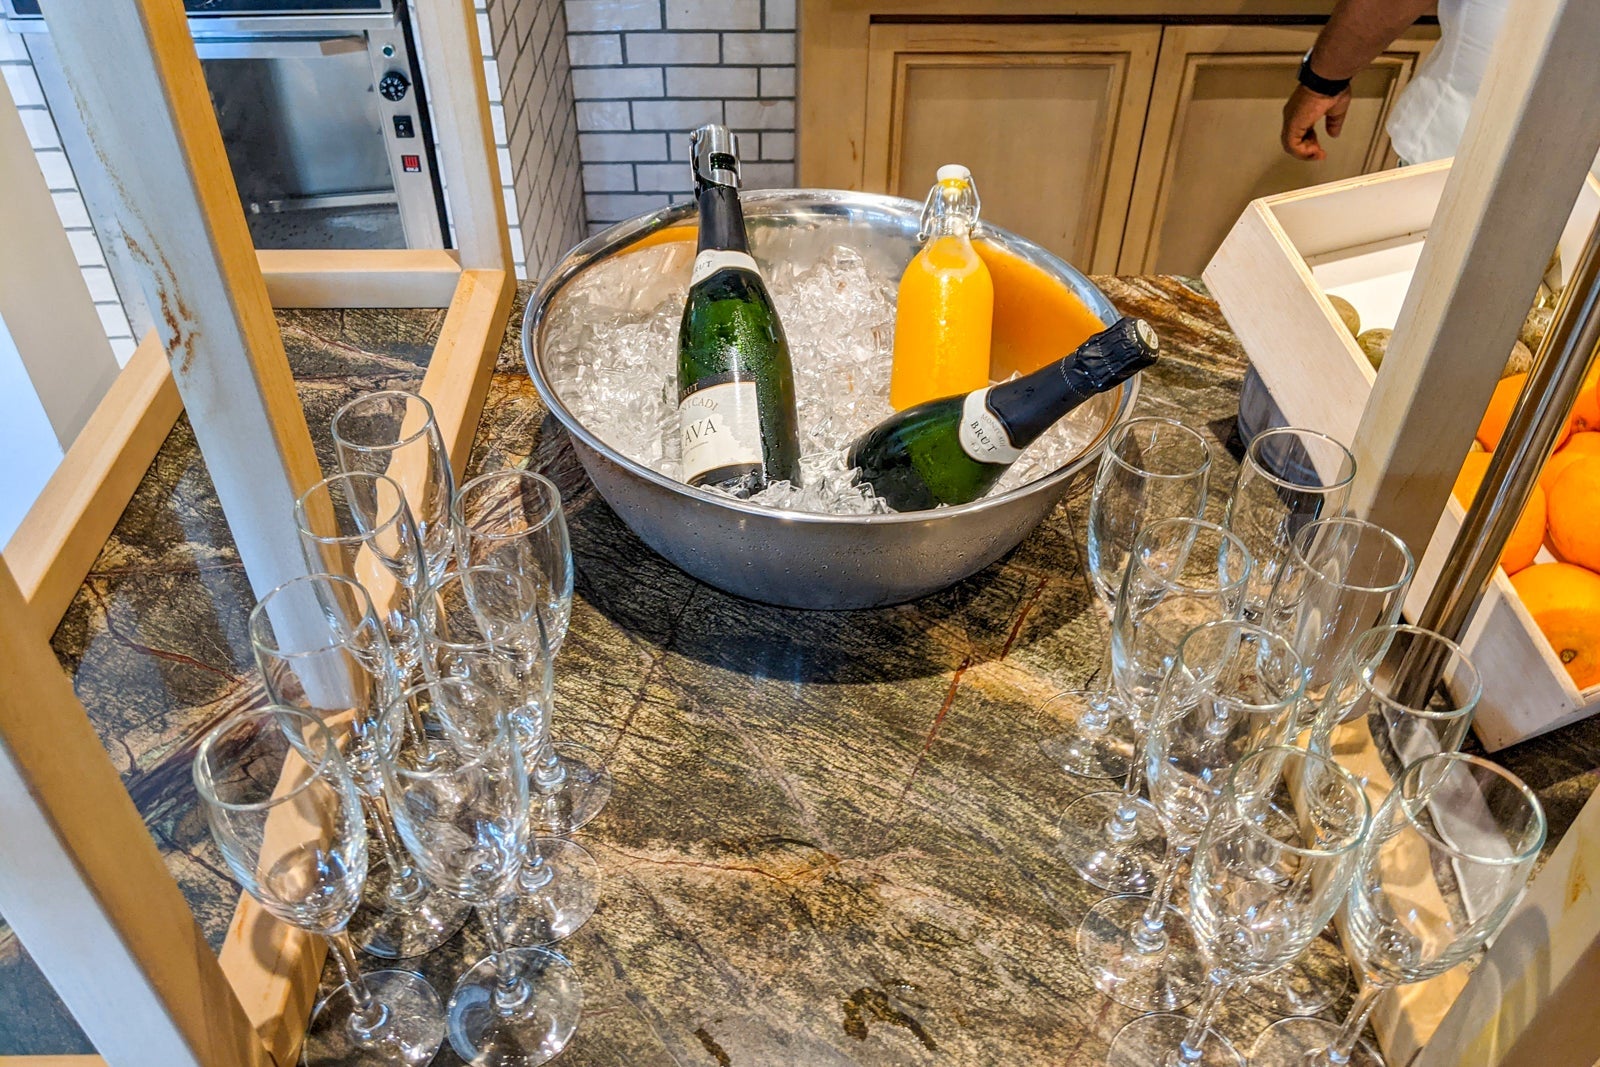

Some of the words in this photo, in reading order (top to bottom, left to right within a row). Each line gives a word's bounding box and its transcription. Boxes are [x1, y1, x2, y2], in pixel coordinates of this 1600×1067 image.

[680, 382, 699, 398] RUT
[682, 418, 717, 446] AVA
[970, 420, 998, 452] BRUT
